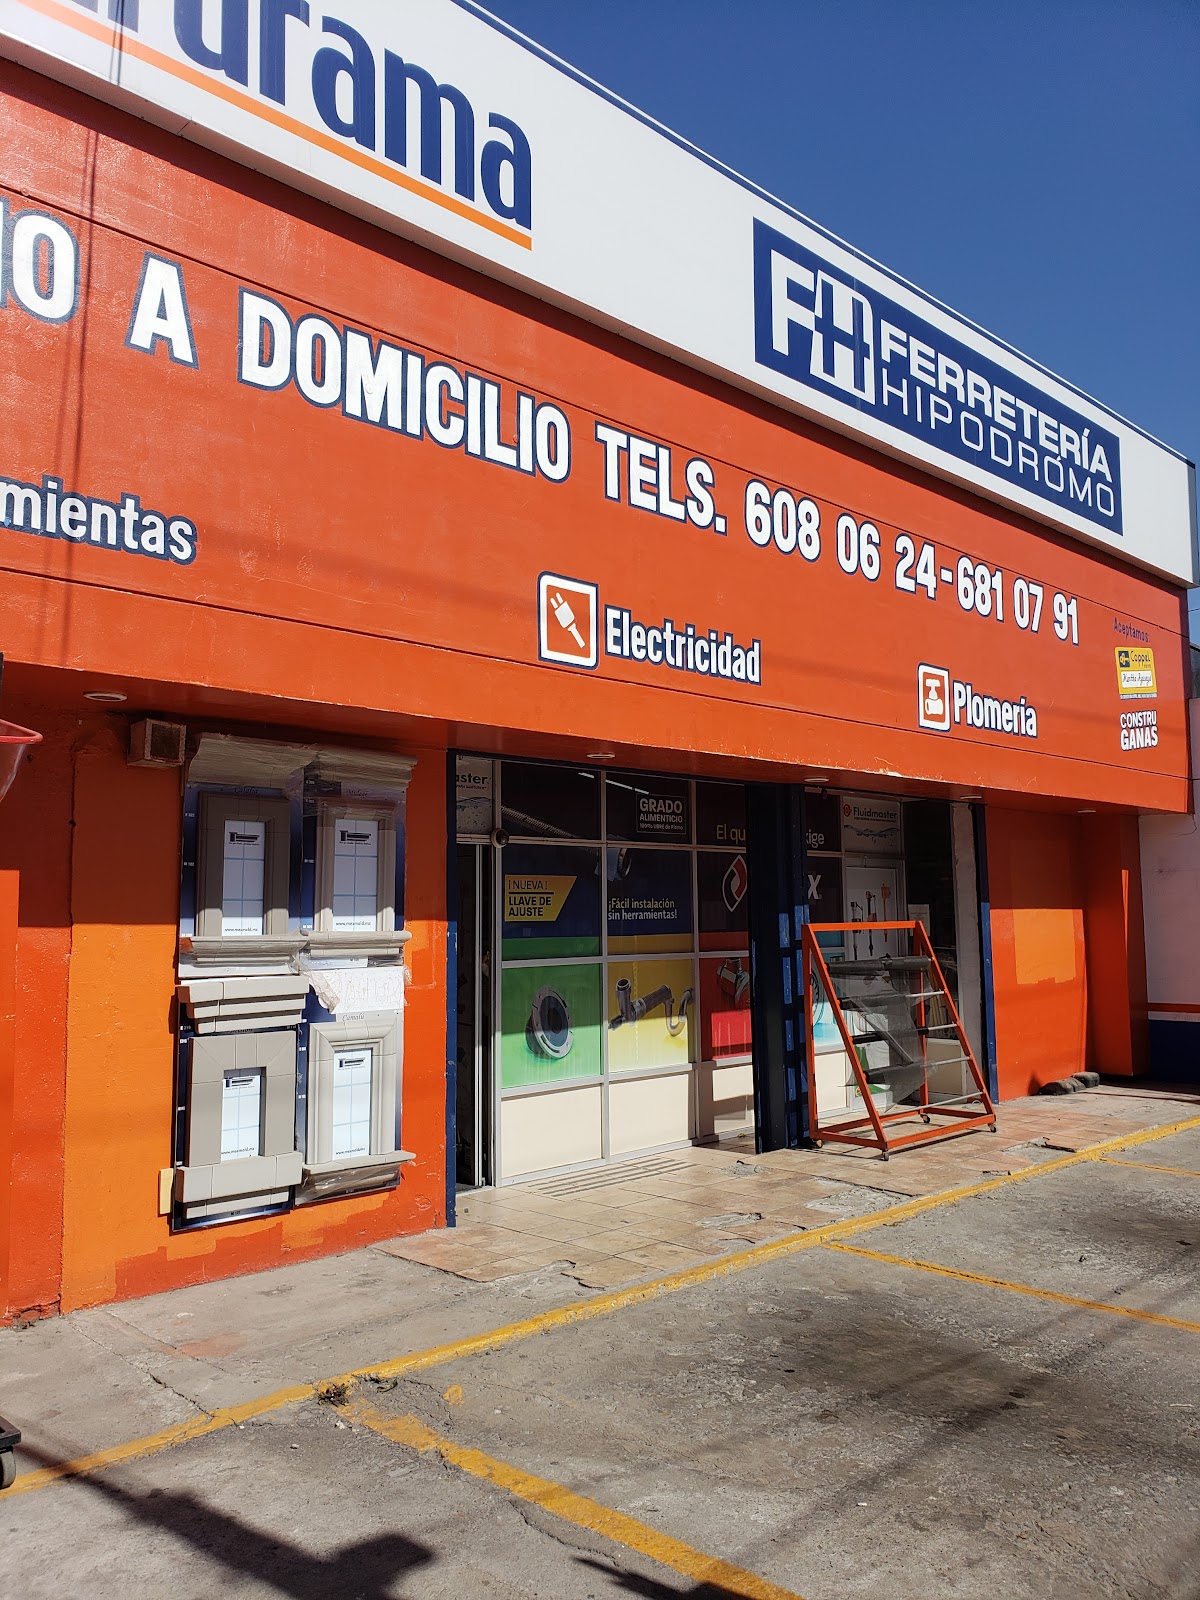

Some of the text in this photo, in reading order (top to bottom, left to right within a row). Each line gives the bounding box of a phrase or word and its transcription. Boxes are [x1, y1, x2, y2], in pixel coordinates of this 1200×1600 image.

[70, 0, 532, 232] urama
[880, 319, 1113, 482] FERRETERÍA
[0, 196, 80, 324] O
[126, 251, 198, 370] A
[238, 286, 572, 483] DOMICILIO
[595, 420, 727, 536] TELS.
[744, 479, 821, 562] 608
[836, 512, 880, 581] 06
[1013, 577, 1044, 634] 07
[1052, 592, 1079, 646] 91
[882, 367, 1115, 517] HIPODRÓMO
[0, 474, 197, 565] mientas
[604, 604, 761, 685] Electricidad
[1130, 650, 1151, 667] Coppel
[952, 681, 1038, 738] Plomería
[1120, 710, 1157, 728] CONSTRU
[1121, 726, 1158, 751] GANAS
[639, 798, 683, 814] GRADO
[853, 806, 897, 819] Fluidmaster
[639, 813, 683, 823] ALIMENTICIO
[716, 823, 727, 840] El
[509, 896, 551, 906] LLAVE DE
[608, 898, 675, 911] ¡Fácil instalación
[508, 907, 544, 917] AJUSTE
[608, 909, 677, 920] sin herramientas!
